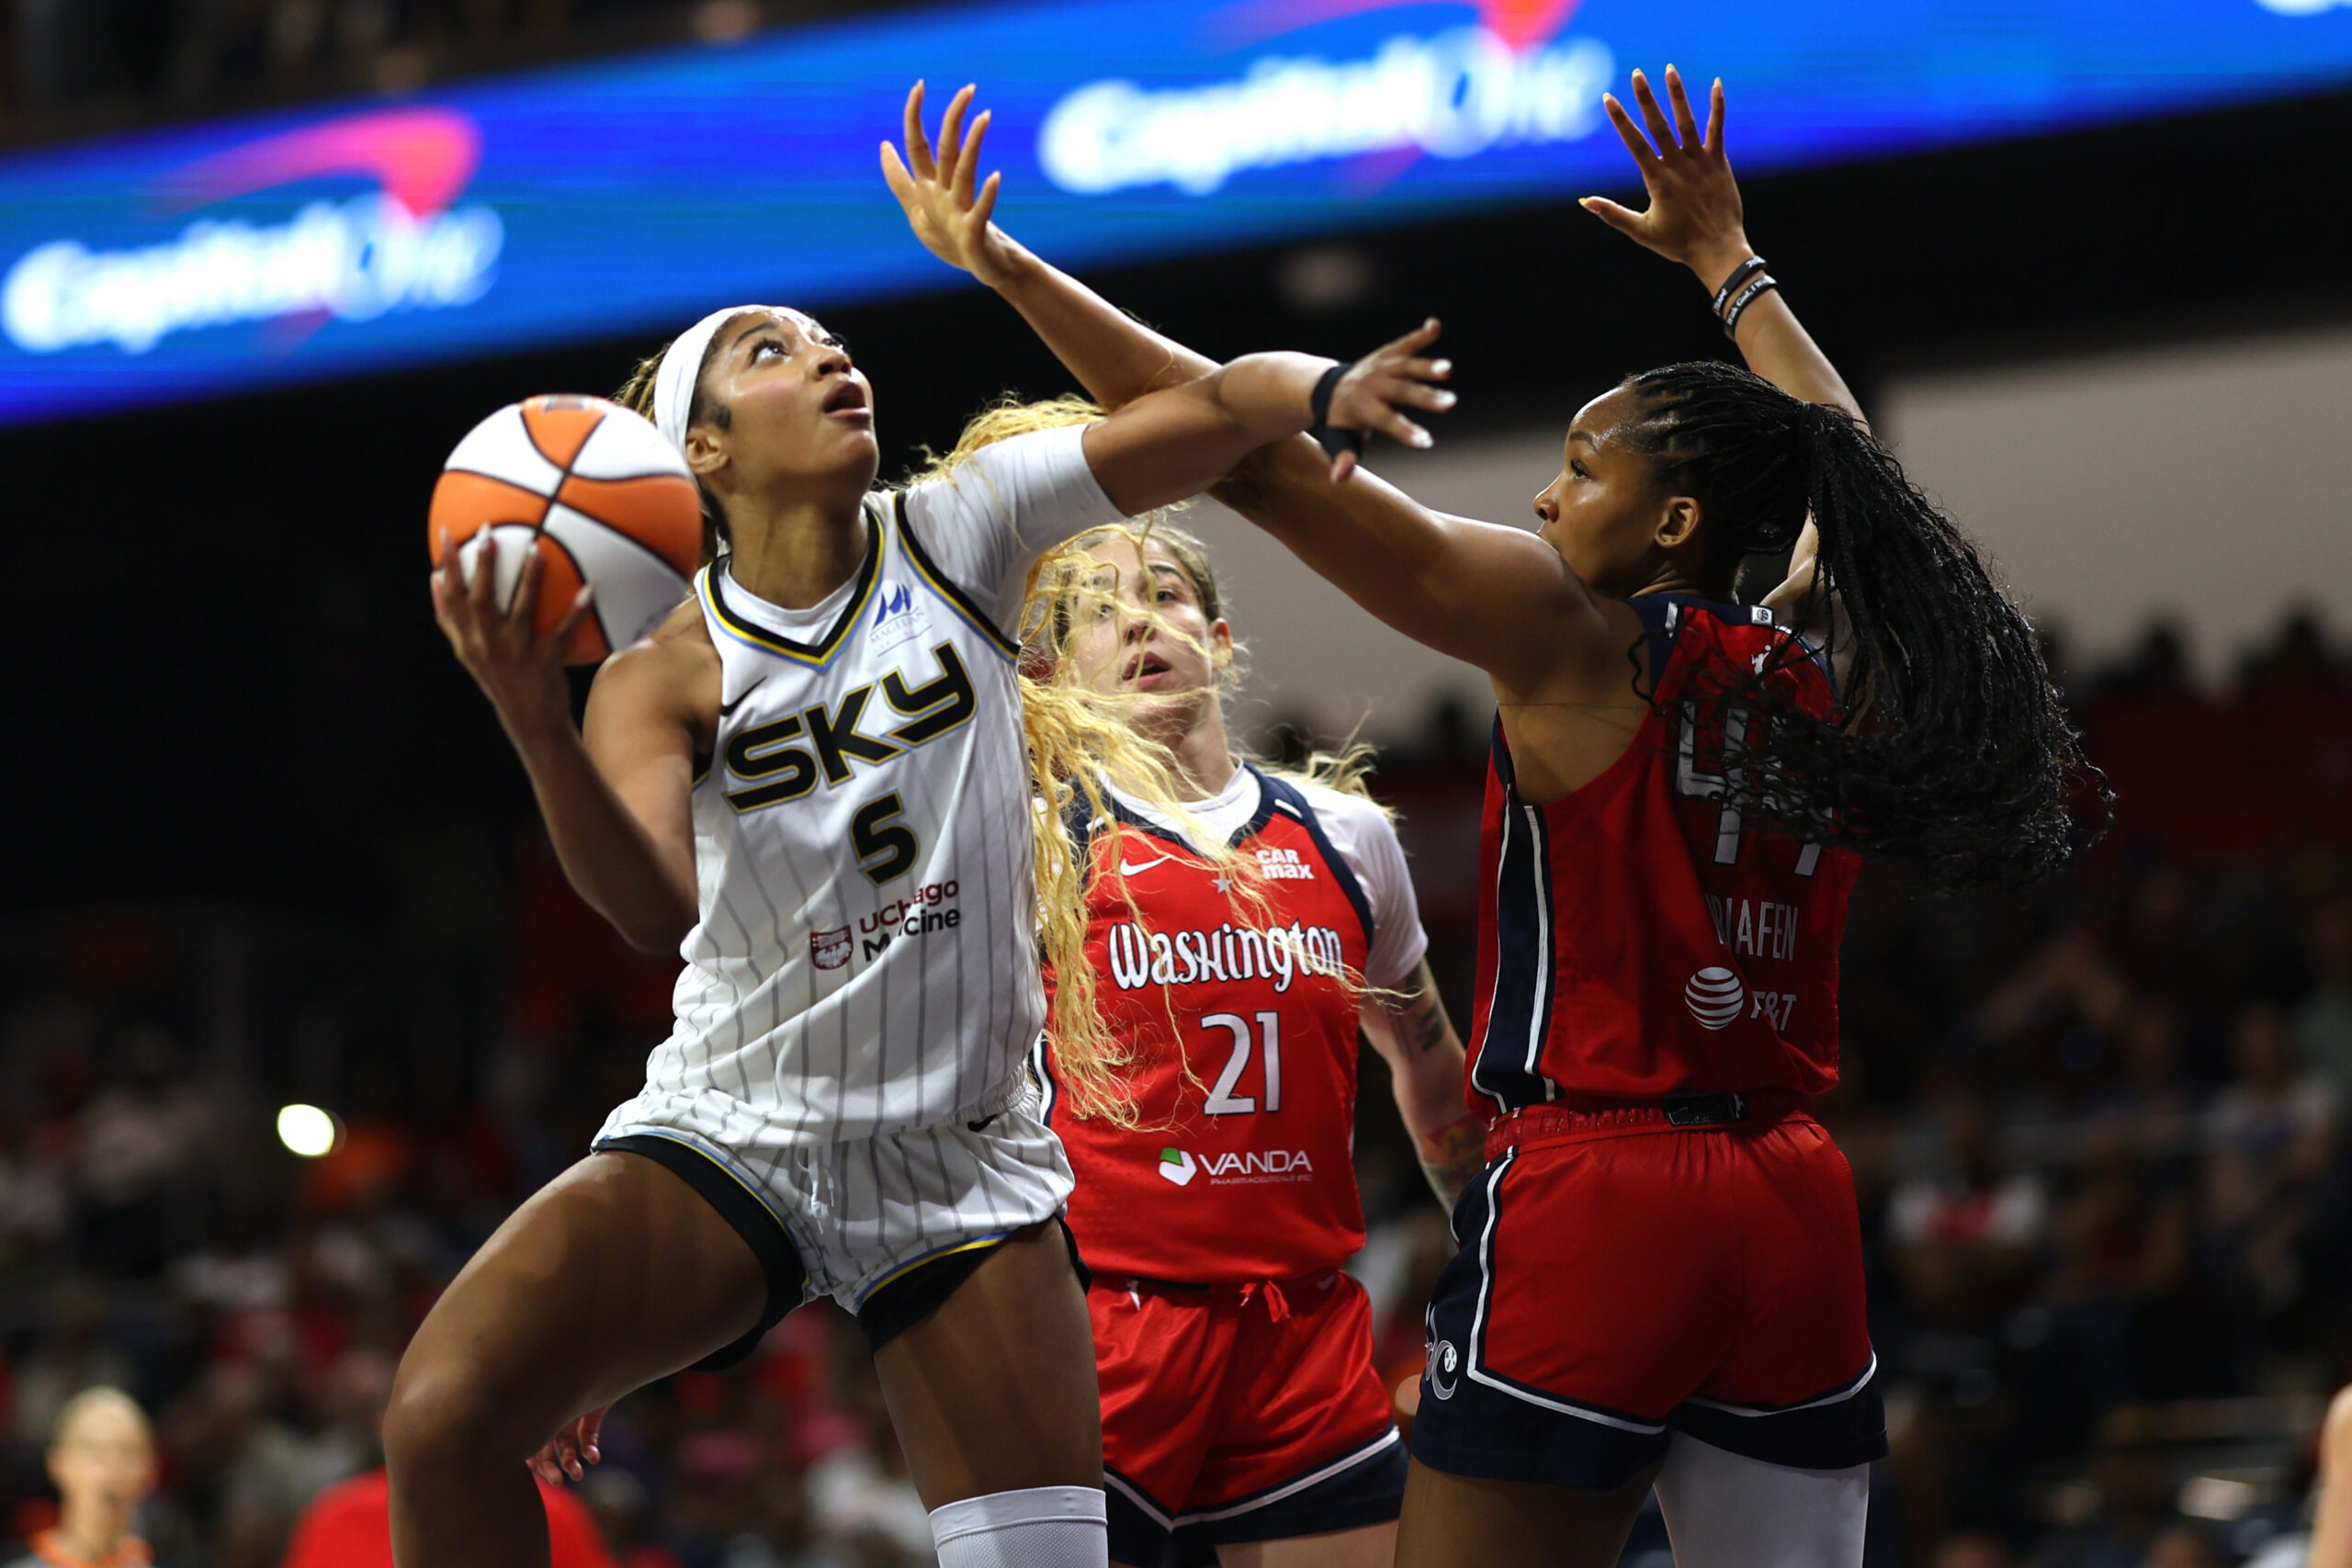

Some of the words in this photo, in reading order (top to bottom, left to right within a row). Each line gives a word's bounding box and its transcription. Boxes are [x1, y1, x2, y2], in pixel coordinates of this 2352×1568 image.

[722, 637, 978, 815] SKY
[850, 787, 919, 887] 5
[1256, 848, 1300, 864] CAR
[1261, 863, 1316, 880] max
[1109, 918, 1346, 993] Washington
[1199, 1010, 1281, 1115] 21
[1198, 1150, 1313, 1176] VANDA
